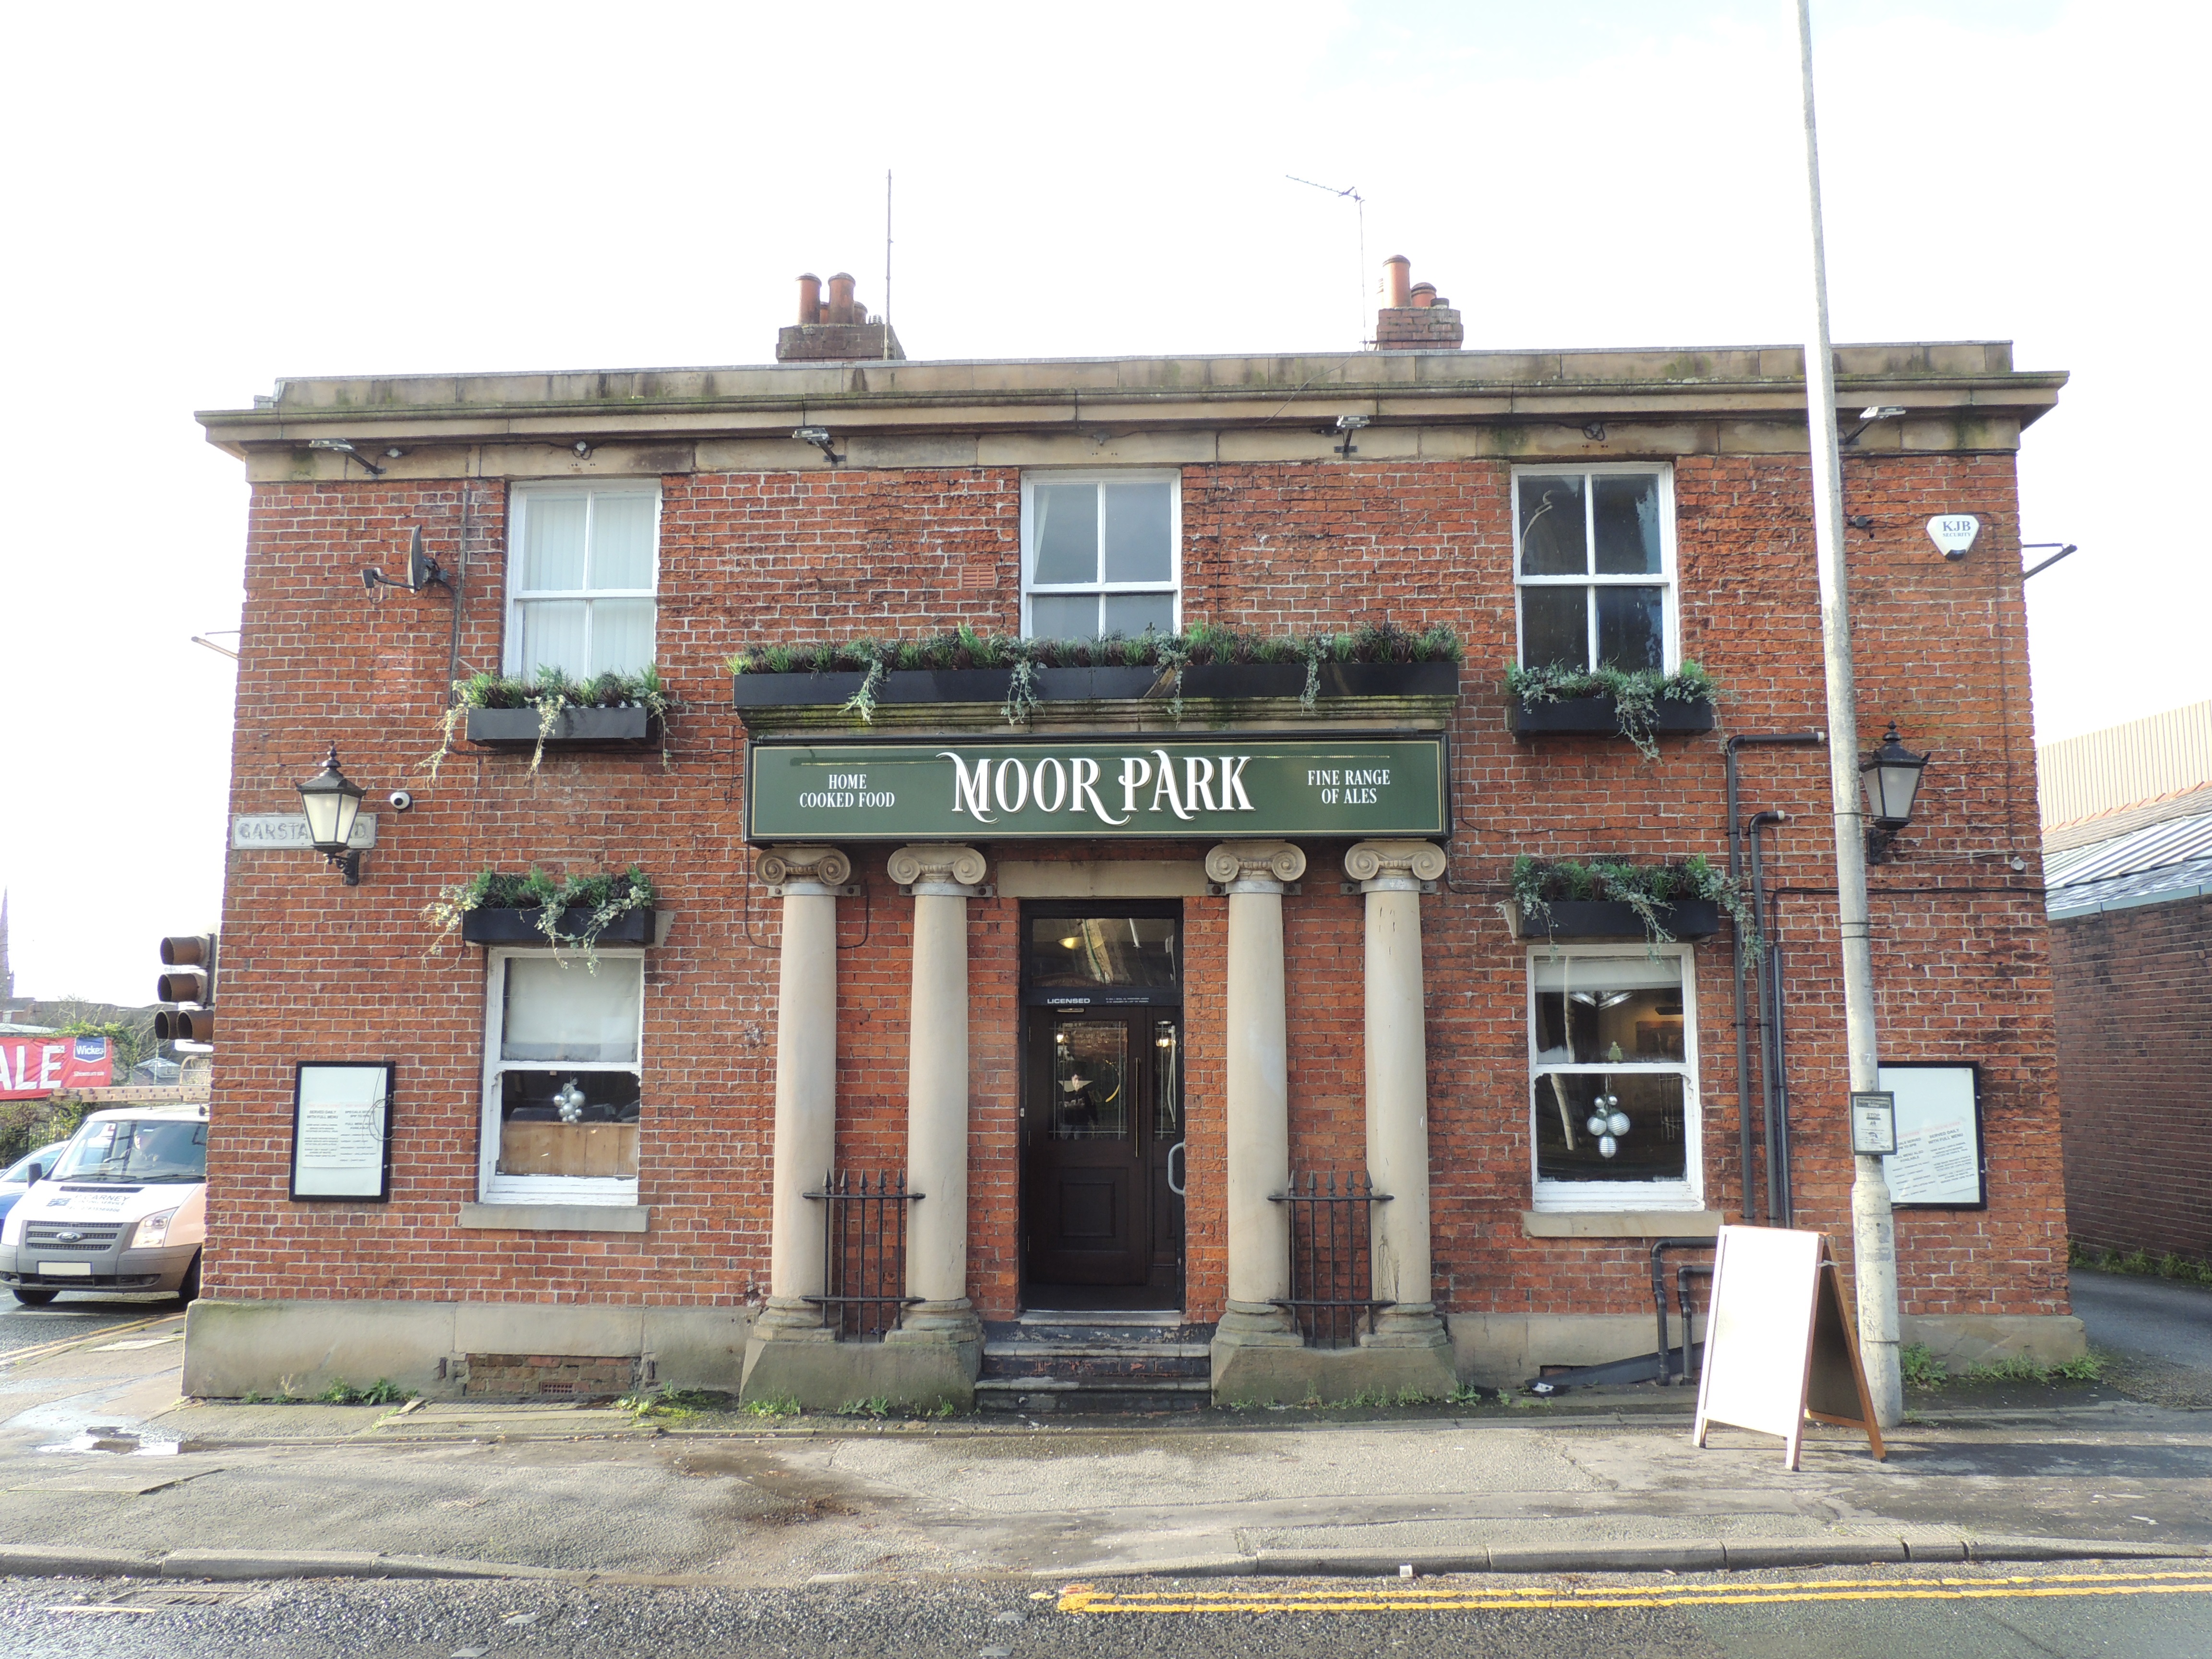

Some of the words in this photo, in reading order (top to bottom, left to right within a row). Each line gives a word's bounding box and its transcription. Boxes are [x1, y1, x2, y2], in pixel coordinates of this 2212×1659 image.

[1943, 521, 1971, 531] KJB
[829, 774, 866, 789] HOME
[1308, 770, 1340, 785] FINE
[1345, 769, 1390, 785] RANGE
[936, 752, 1131, 826] MOOR
[1118, 750, 1256, 821] PARK
[1322, 788, 1339, 804] OF
[1343, 788, 1377, 804] ALES
[799, 792, 854, 808] COOKED
[858, 792, 895, 807] FOOD
[239, 822, 311, 840] GARSTA
